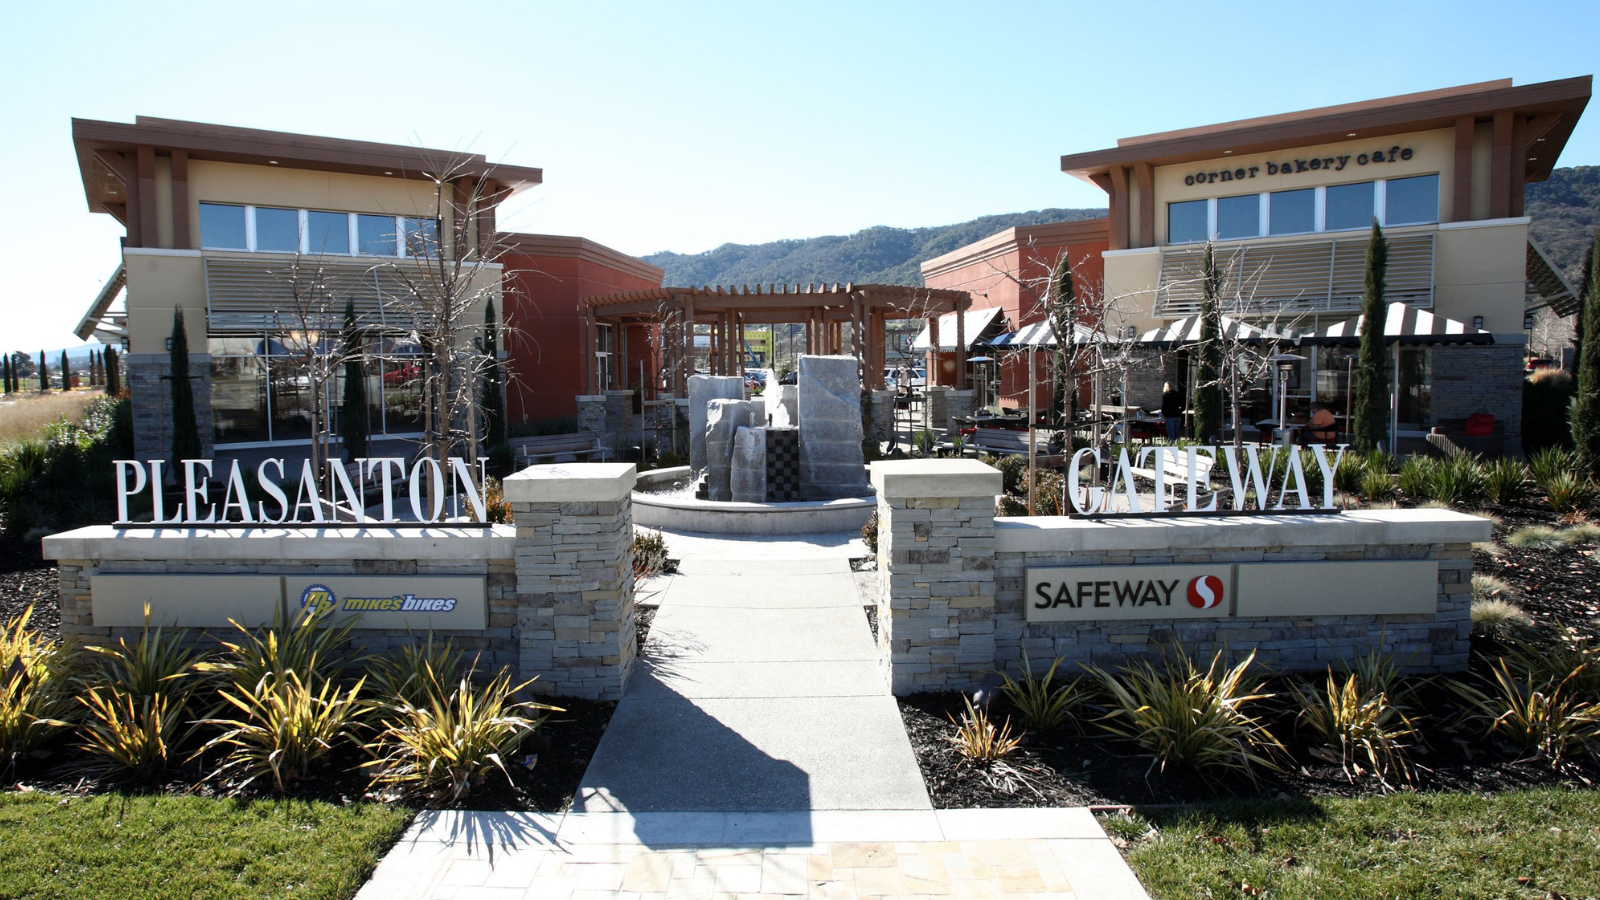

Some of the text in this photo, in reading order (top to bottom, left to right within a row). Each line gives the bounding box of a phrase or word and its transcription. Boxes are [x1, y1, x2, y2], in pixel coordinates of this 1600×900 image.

[1184, 145, 1414, 187] corner bakery cafe
[111, 456, 490, 525] PLEASANTON
[1068, 443, 1350, 515] GATEWAY
[1034, 579, 1180, 609] SAFEWAY
